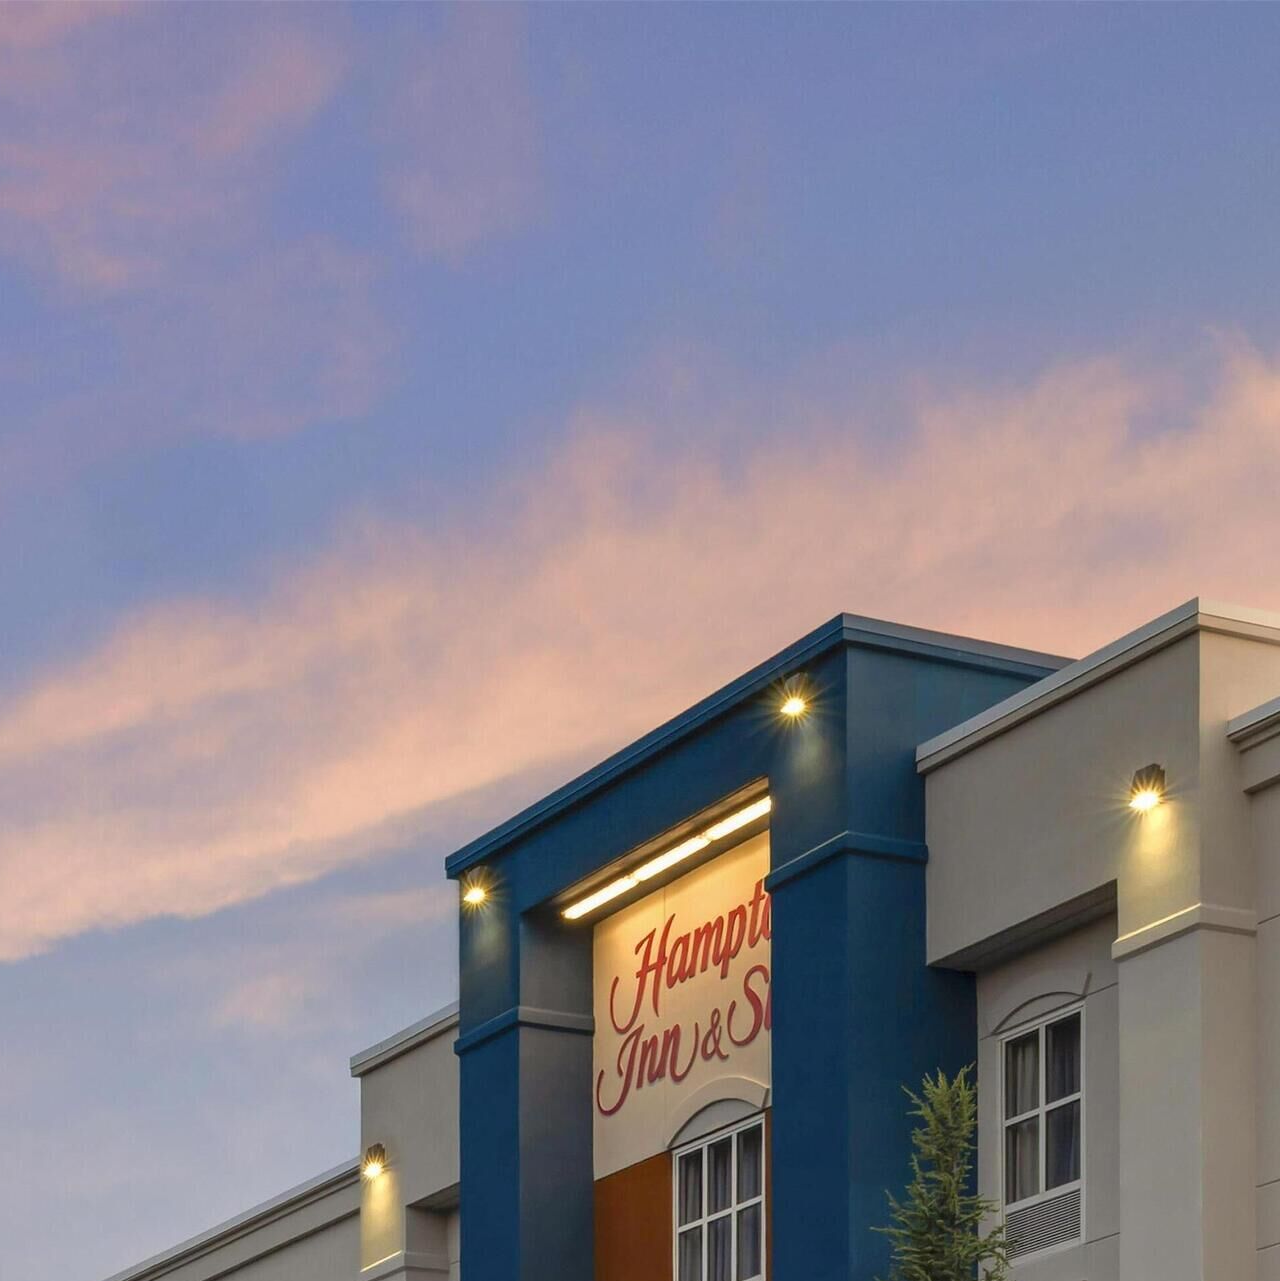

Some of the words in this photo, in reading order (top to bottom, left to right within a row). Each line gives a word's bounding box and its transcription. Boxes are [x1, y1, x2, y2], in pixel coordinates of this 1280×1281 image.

[596, 1023, 698, 1116] Inn
[701, 1008, 729, 1061] &
[727, 964, 771, 1047] S
